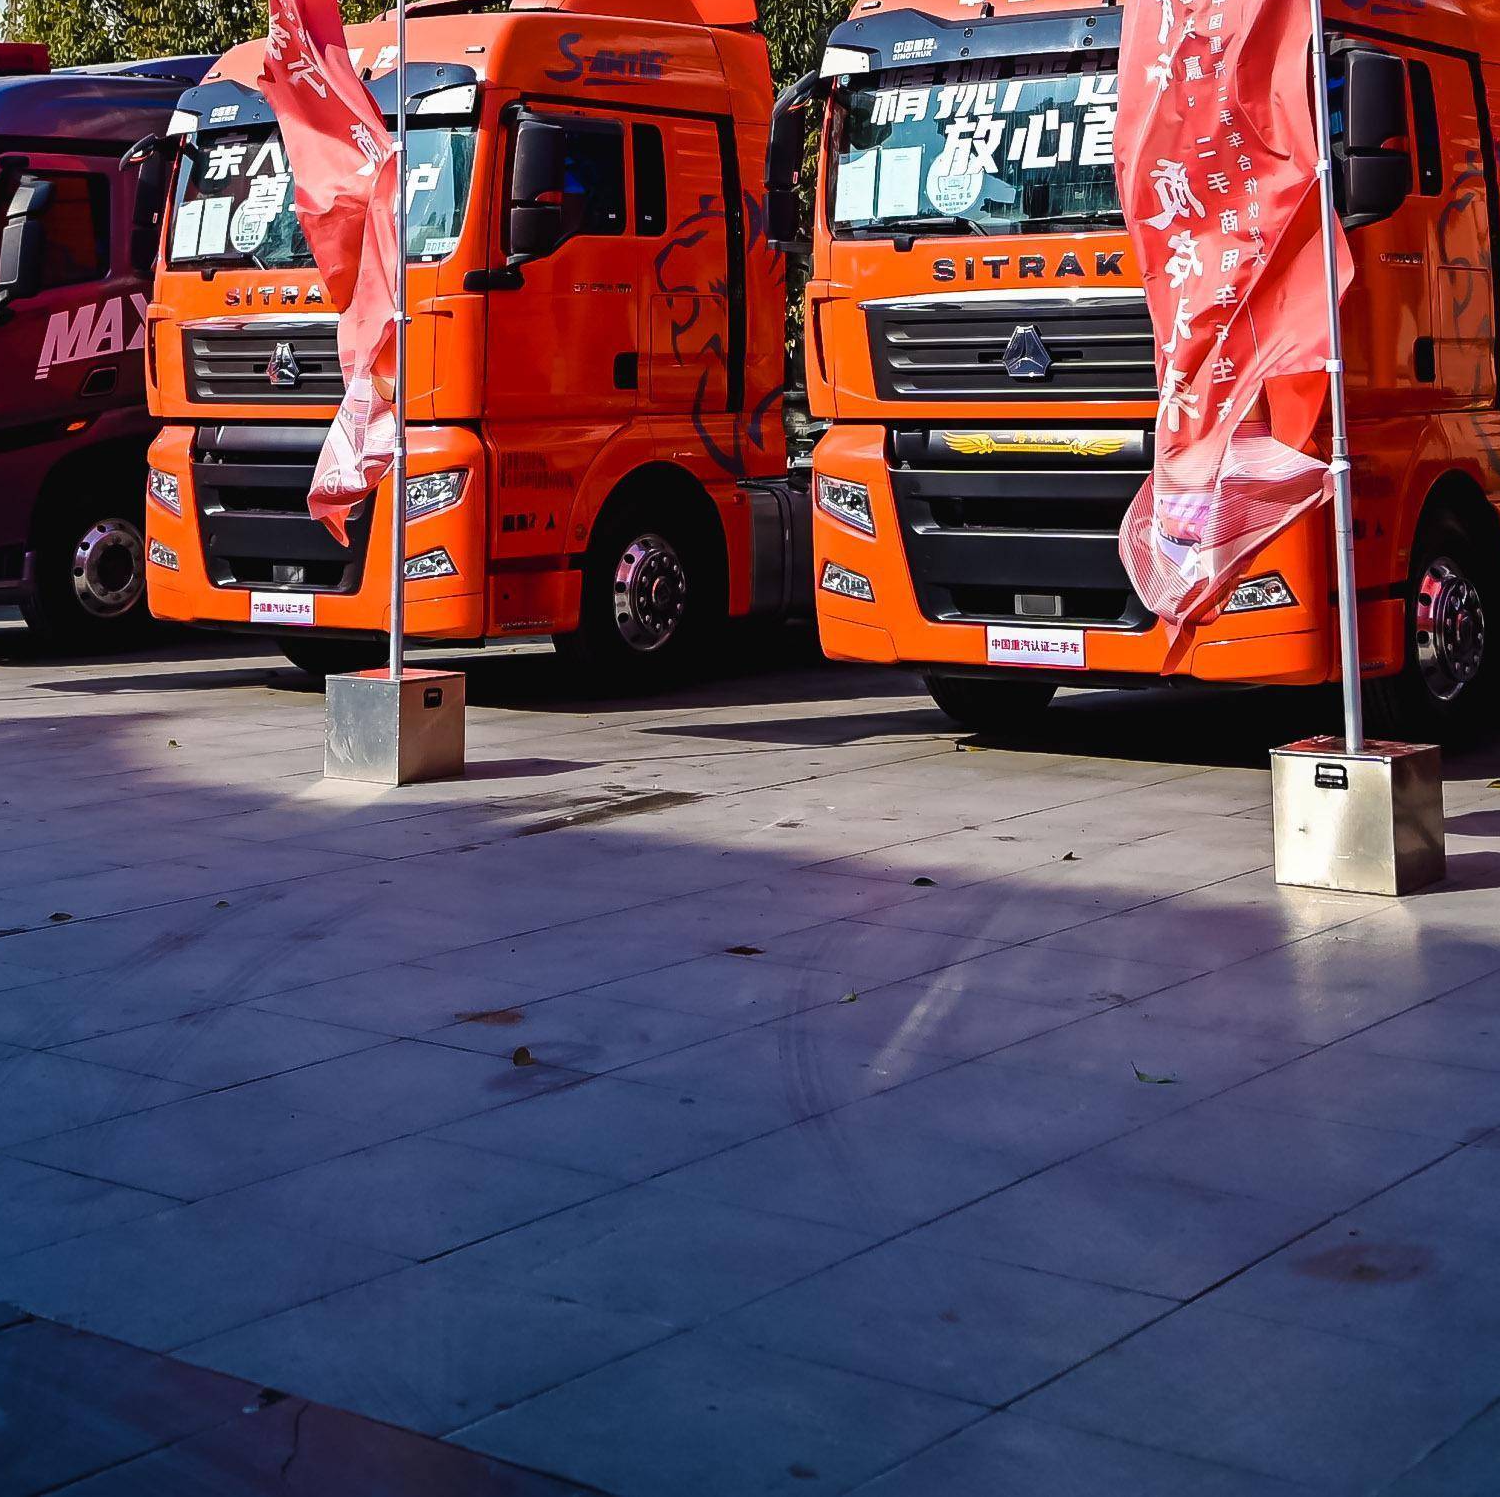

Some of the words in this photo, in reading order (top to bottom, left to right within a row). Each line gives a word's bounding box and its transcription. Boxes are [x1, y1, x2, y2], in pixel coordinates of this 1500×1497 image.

[932, 251, 1126, 283] SITRAK
[991, 638, 1080, 654] 中国重汽认证二手车
